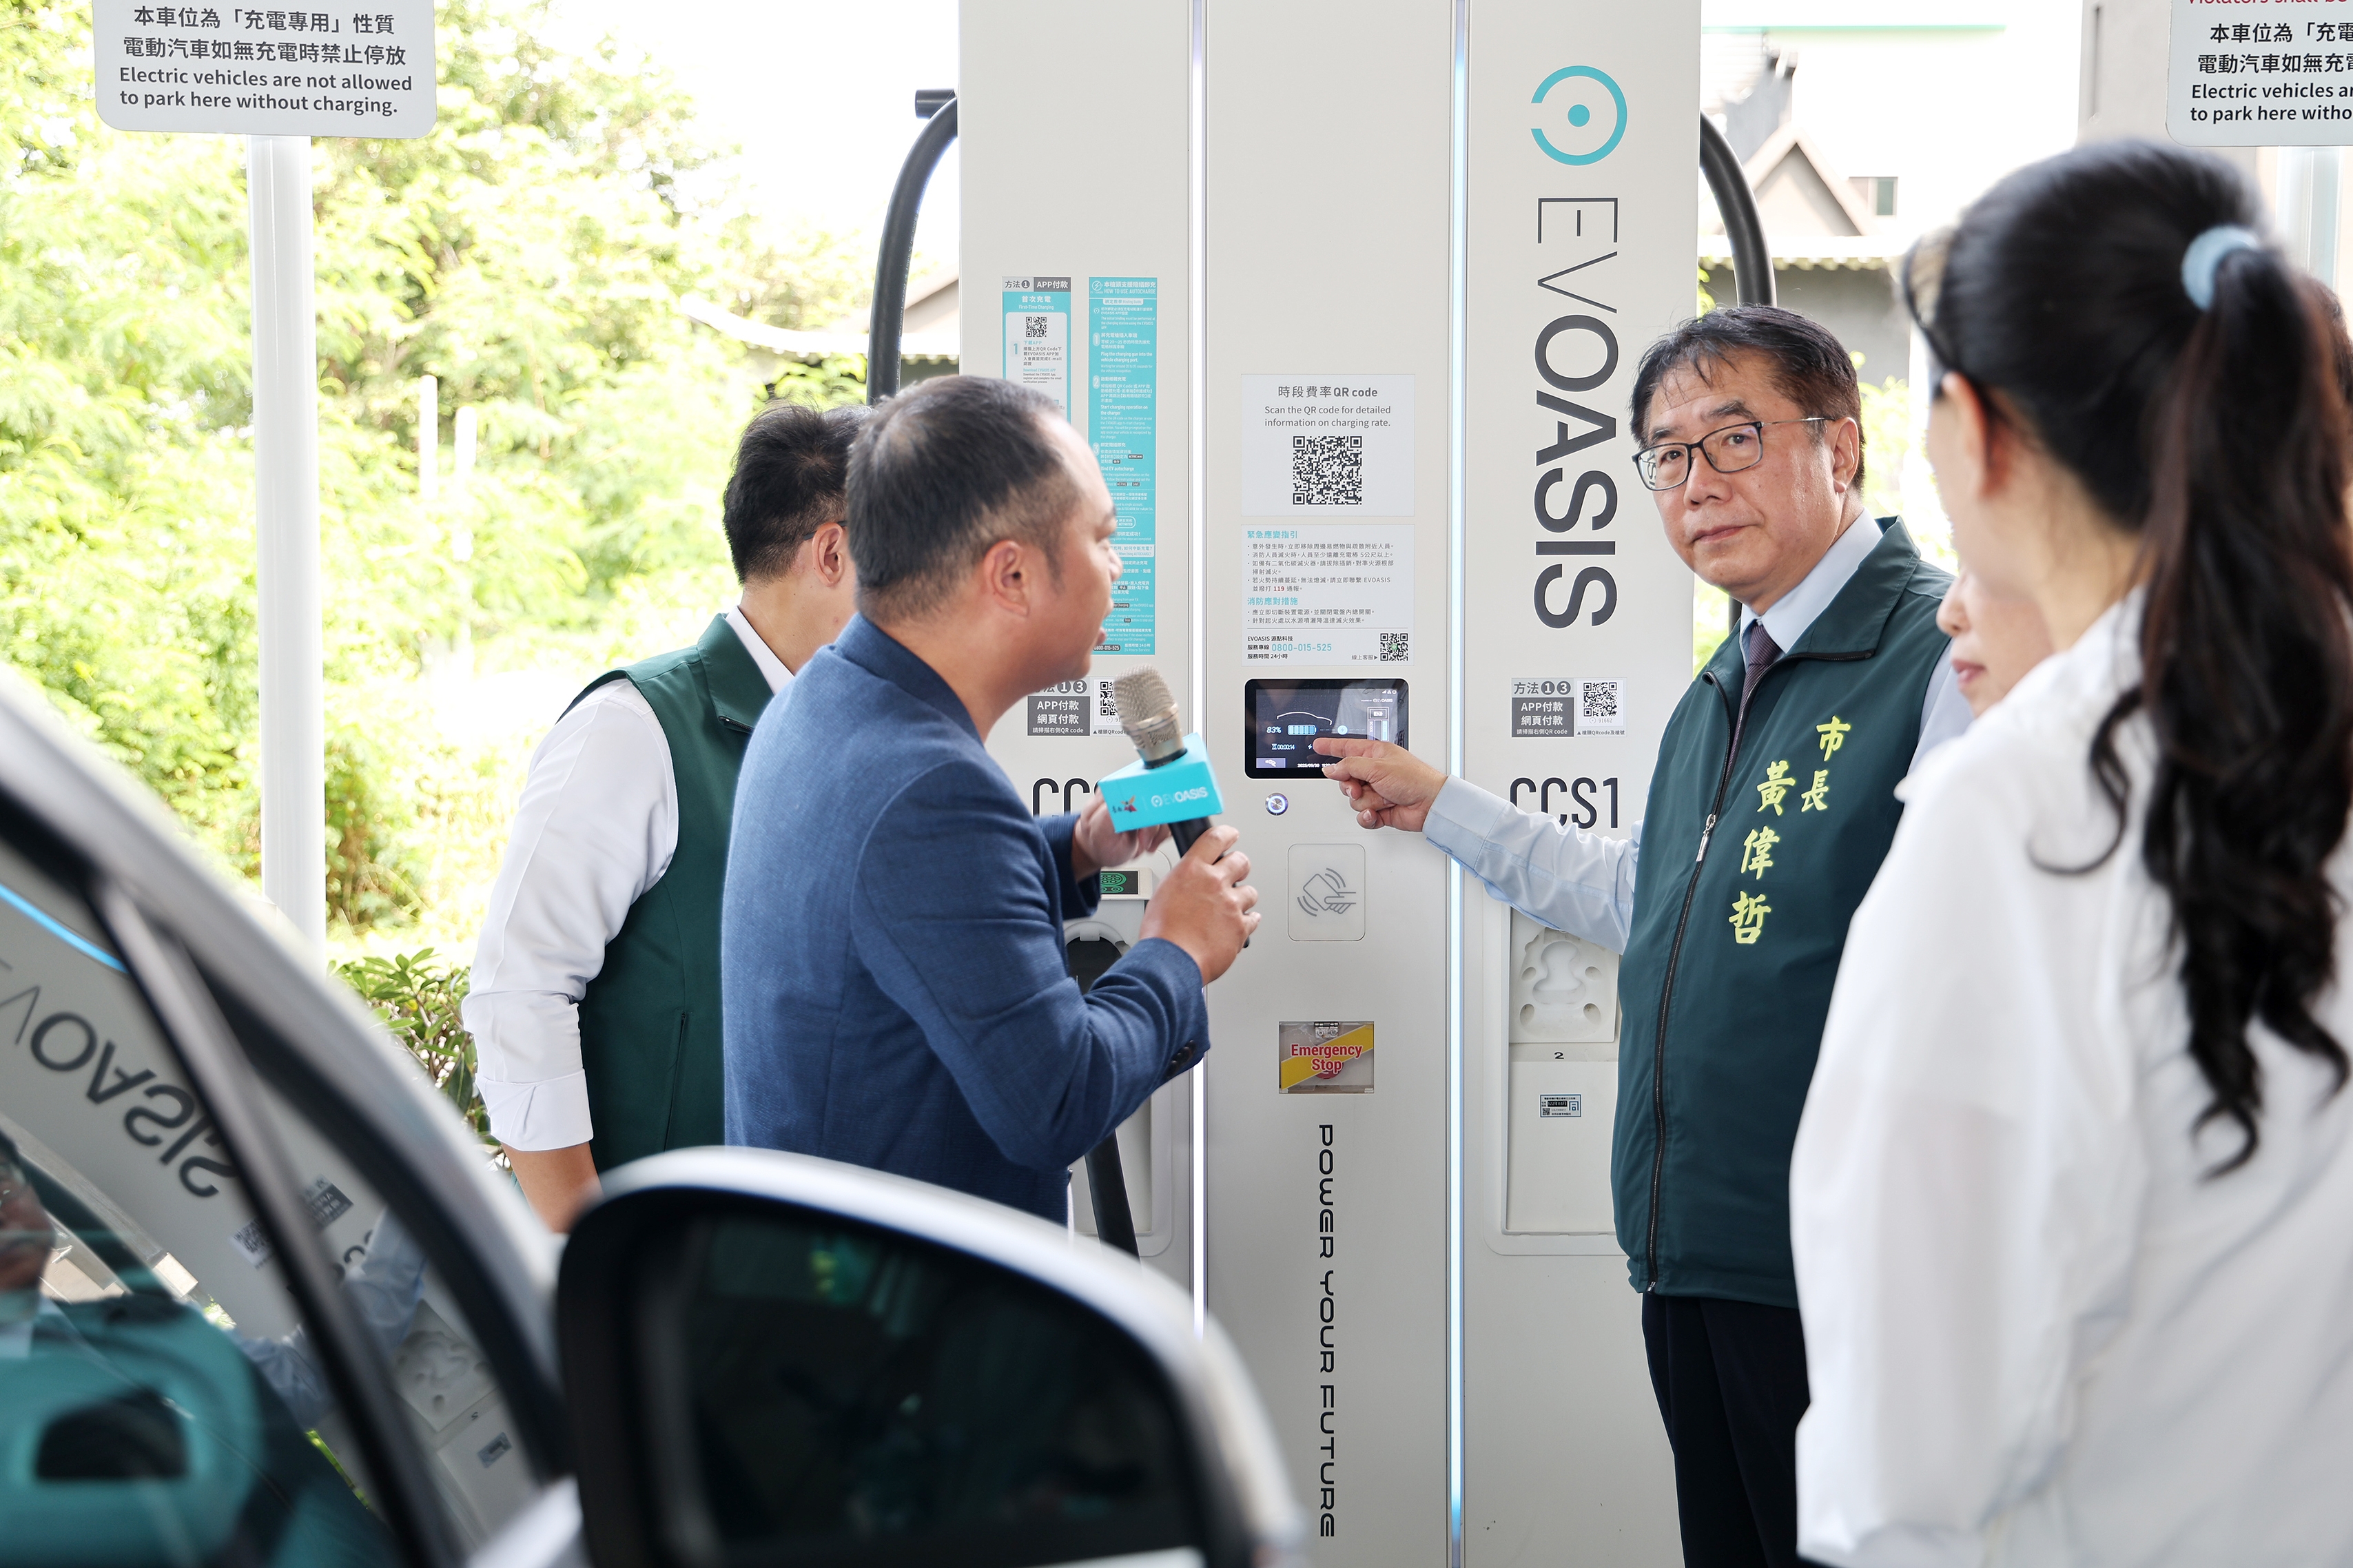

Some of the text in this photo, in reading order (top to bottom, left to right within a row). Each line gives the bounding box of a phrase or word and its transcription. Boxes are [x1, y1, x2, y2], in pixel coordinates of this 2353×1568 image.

[122, 36, 408, 67] 電動汽車如無充電時禁止停放
[2197, 52, 2353, 74] 電動汽車如無充
[119, 66, 413, 91] Electric vehicles are not allowed
[2191, 83, 2257, 100] Electric
[2262, 83, 2334, 99] vehicles
[119, 90, 399, 116] to park here without charging.
[2190, 107, 2208, 121] to
[2212, 105, 2253, 125] park
[2258, 105, 2297, 121] here
[1036, 280, 1069, 289] APP付款
[1094, 334, 1098, 344] 1
[1014, 343, 1018, 355] 1
[1093, 377, 1099, 387] 2
[1352, 387, 1378, 397] code
[1265, 406, 1391, 415] Scan the QR code for detailed
[1533, 197, 1619, 629] EVOASIS
[1265, 418, 1316, 426] information
[1331, 418, 1369, 429] charging
[1247, 530, 1298, 539] 緊急應變指引
[1247, 597, 1298, 606] 消防應對措施
[1271, 643, 1332, 652] 0800-015-525
[1037, 701, 1079, 711] APP付款
[1521, 701, 1563, 712] APP付款
[1037, 714, 1079, 725] 網頁付款
[1521, 715, 1563, 726] 網頁付款
[1801, 715, 1851, 812] 市長
[1510, 777, 1619, 829] CCS1
[1728, 760, 1796, 945] 黃偉哲
[1291, 1044, 1363, 1059] Emergency
[1554, 1051, 1565, 1060] 2
[1311, 1058, 1343, 1074] Stop
[1319, 1124, 1335, 1538] POWER YOUR FUTURE
